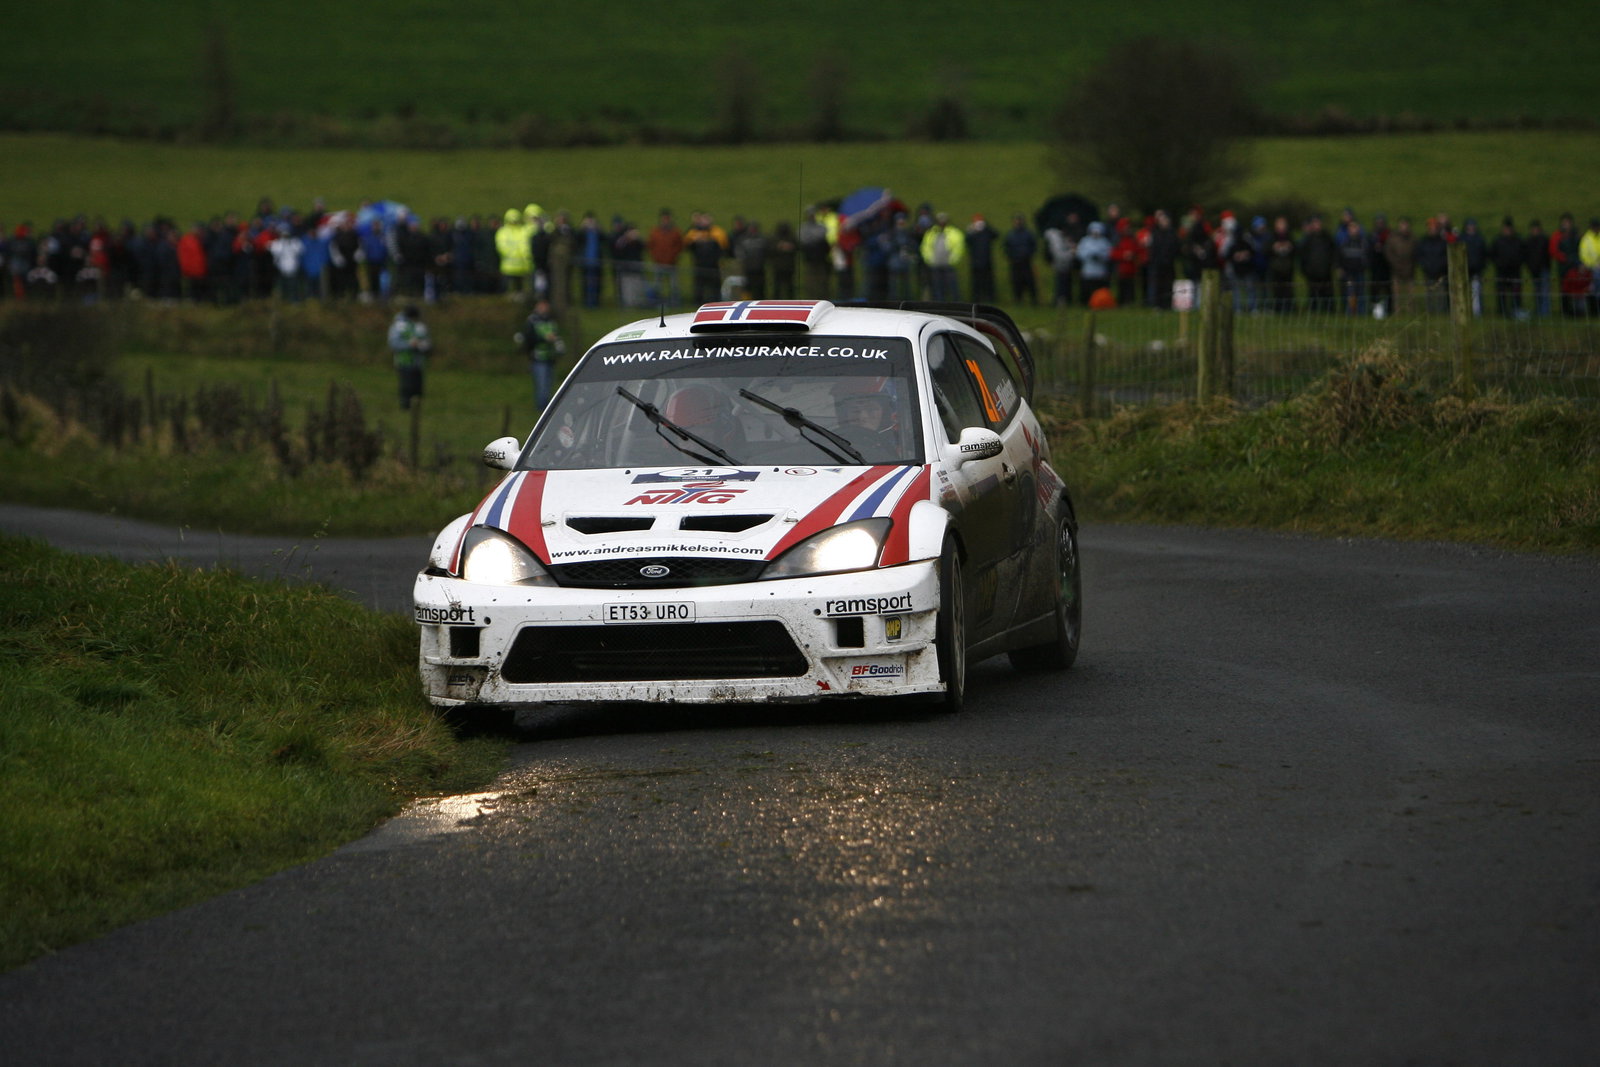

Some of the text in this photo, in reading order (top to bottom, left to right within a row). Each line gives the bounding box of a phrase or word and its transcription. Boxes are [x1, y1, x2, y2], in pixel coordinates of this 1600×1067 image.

[602, 345, 888, 366] WWW.RALLYINSURANCE.CO.UK
[551, 544, 764, 559] www.andreasmikkelsen.com
[826, 592, 913, 615] ramsport
[609, 604, 689, 620] ET53 URO
[851, 664, 904, 676] BFGoodrich
